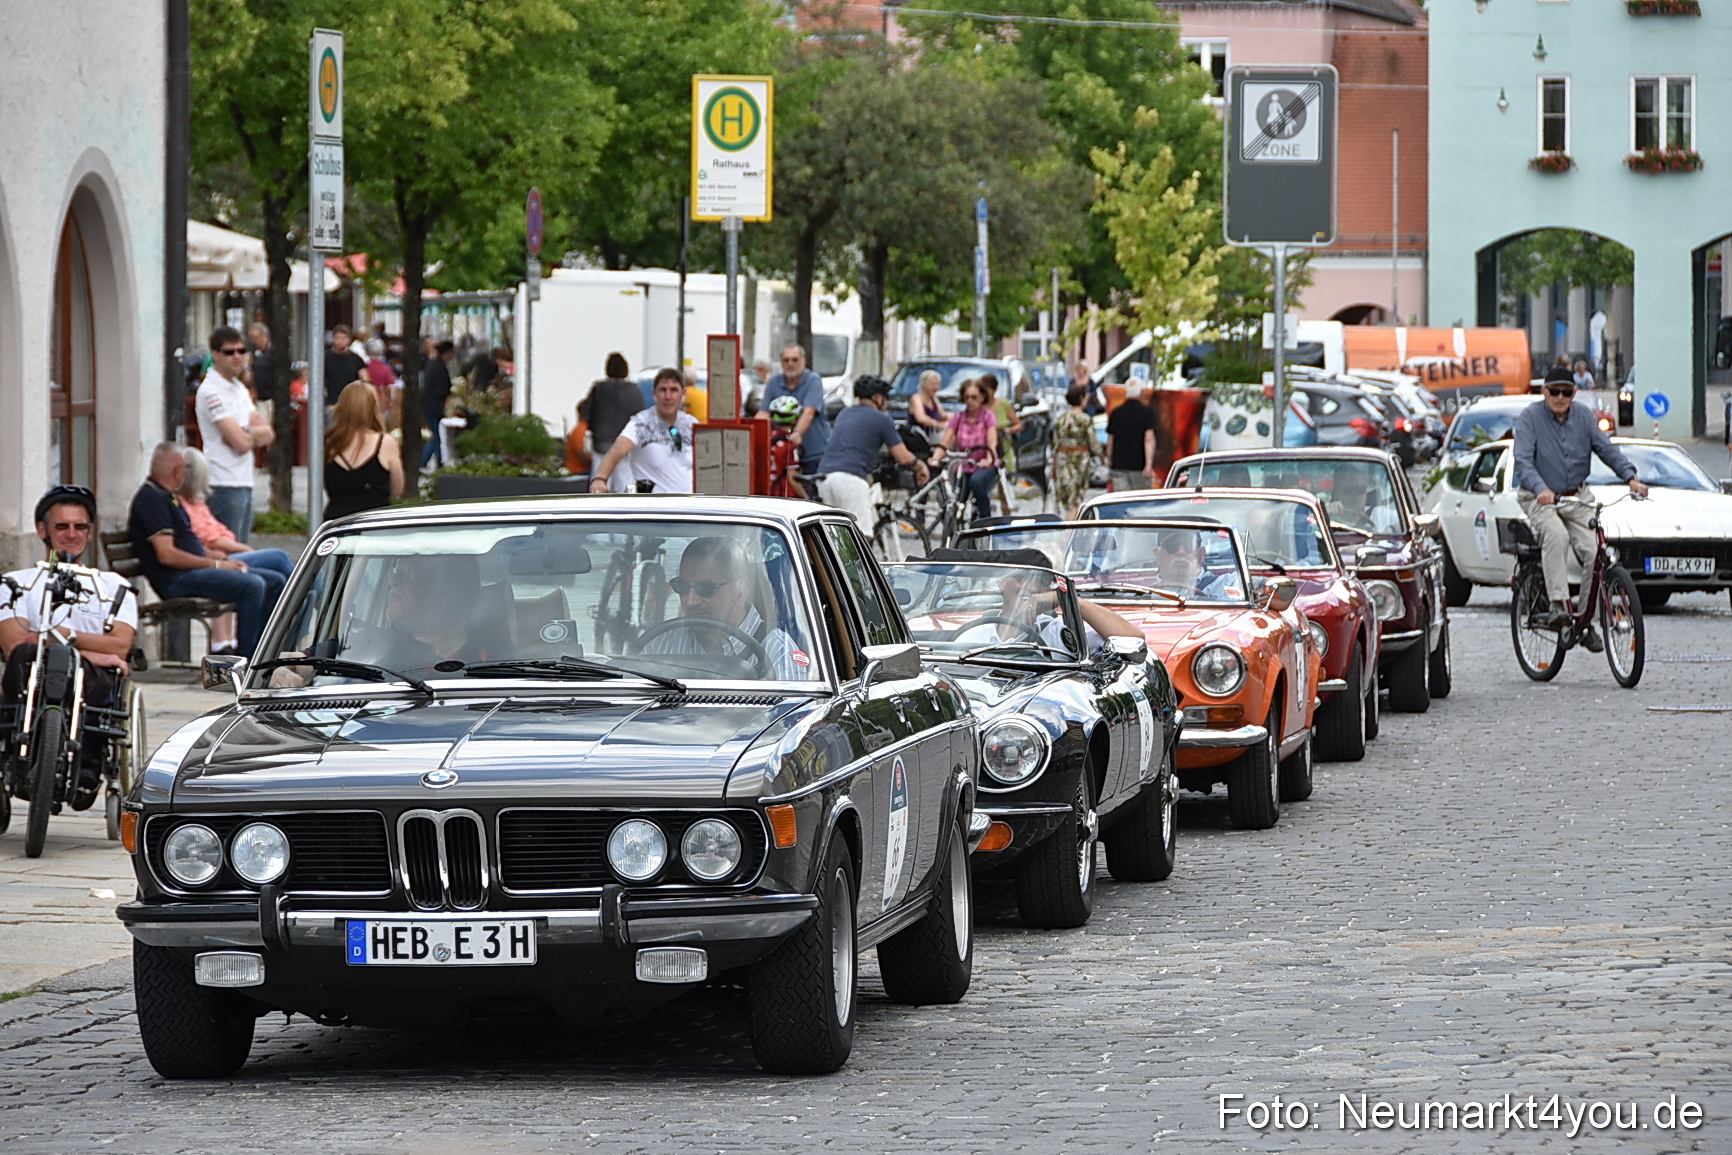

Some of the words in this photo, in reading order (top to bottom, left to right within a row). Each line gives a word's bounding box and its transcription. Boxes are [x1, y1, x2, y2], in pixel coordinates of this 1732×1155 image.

[721, 101, 743, 136] H
[1261, 143, 1300, 157] ZONE
[712, 158, 750, 168] Rathaus
[371, 925, 430, 960] HEB
[454, 926, 474, 960] E
